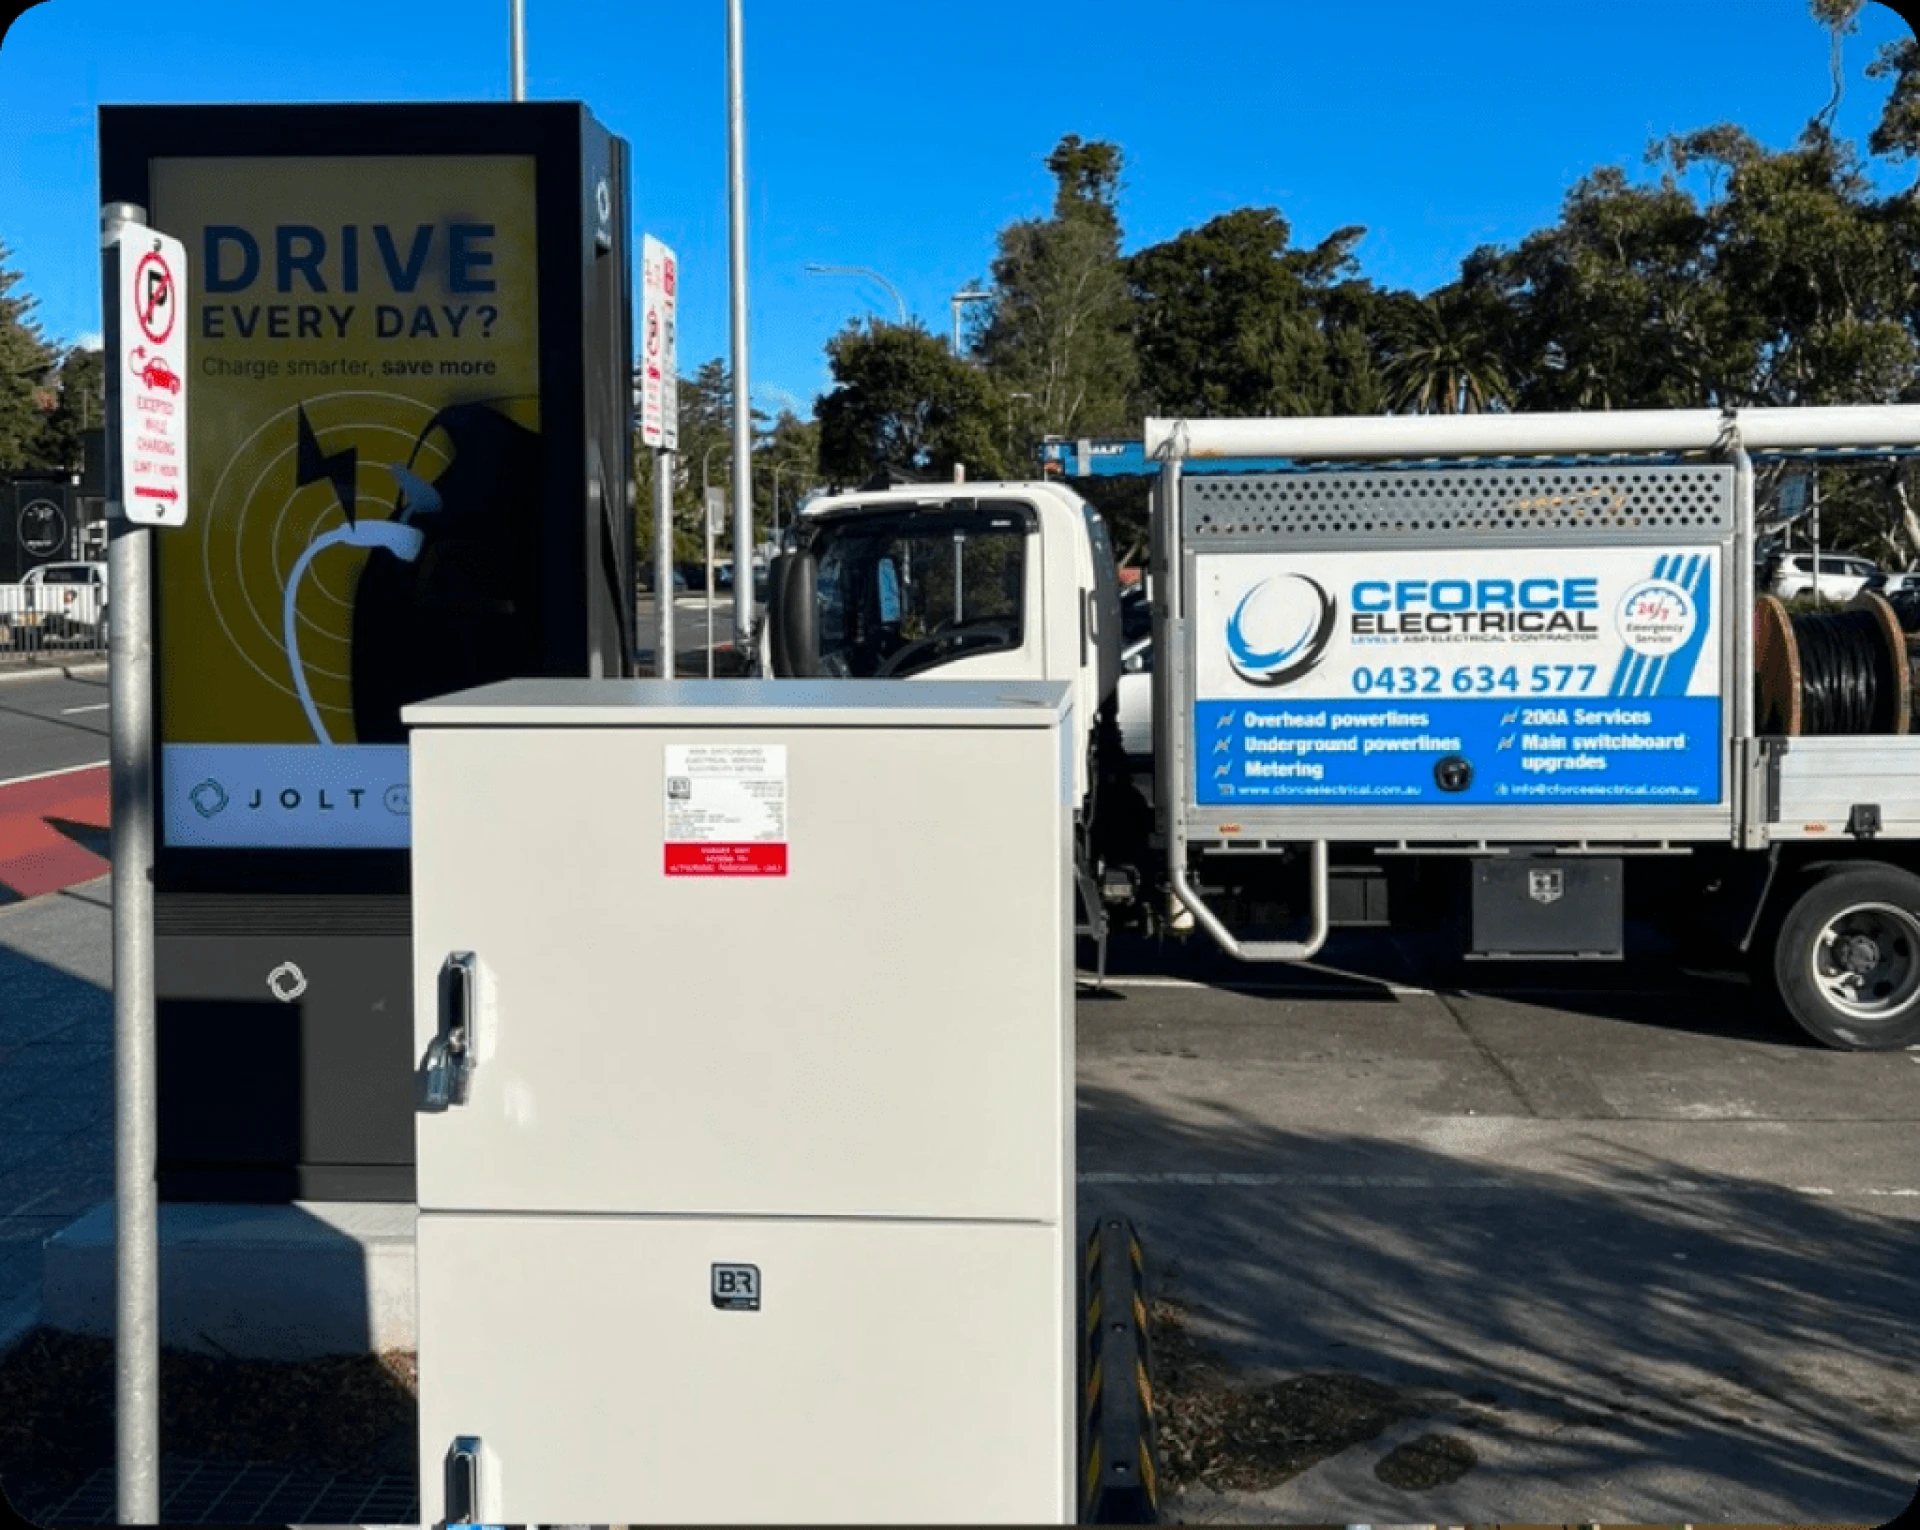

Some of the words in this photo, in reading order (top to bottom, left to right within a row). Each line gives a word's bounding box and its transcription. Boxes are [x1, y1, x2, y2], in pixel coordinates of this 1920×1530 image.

[203, 224, 496, 293] DRIVE
[202, 305, 355, 338] EVERY
[376, 305, 498, 338] DAY?
[202, 357, 278, 379] Charge
[286, 358, 374, 378] smarter,
[381, 360, 434, 376] save
[440, 360, 497, 376] more
[1351, 577, 1598, 612] CFORCE
[1351, 611, 1599, 634] ELECTRICAL
[1625, 623, 1685, 635] Emergency
[1430, 634, 1507, 643] ELECTRICAL
[1511, 633, 1599, 643] CONTRACTOR
[1635, 634, 1673, 643] Service
[1351, 666, 1442, 694] 0432
[1451, 665, 1520, 693] 634
[1530, 664, 1598, 692] 577
[1244, 711, 1327, 728] Overhead
[1331, 710, 1430, 730] powerlines
[1521, 709, 1569, 726] 200A
[1573, 708, 1653, 726] Services
[1244, 736, 1358, 756] Underground
[1363, 734, 1462, 756] powerlines
[1521, 733, 1567, 751] Main
[1572, 732, 1687, 751] switchboard
[1244, 760, 1325, 780] Metering
[1521, 753, 1608, 774] upgrades
[248, 788, 366, 811] JOLT
